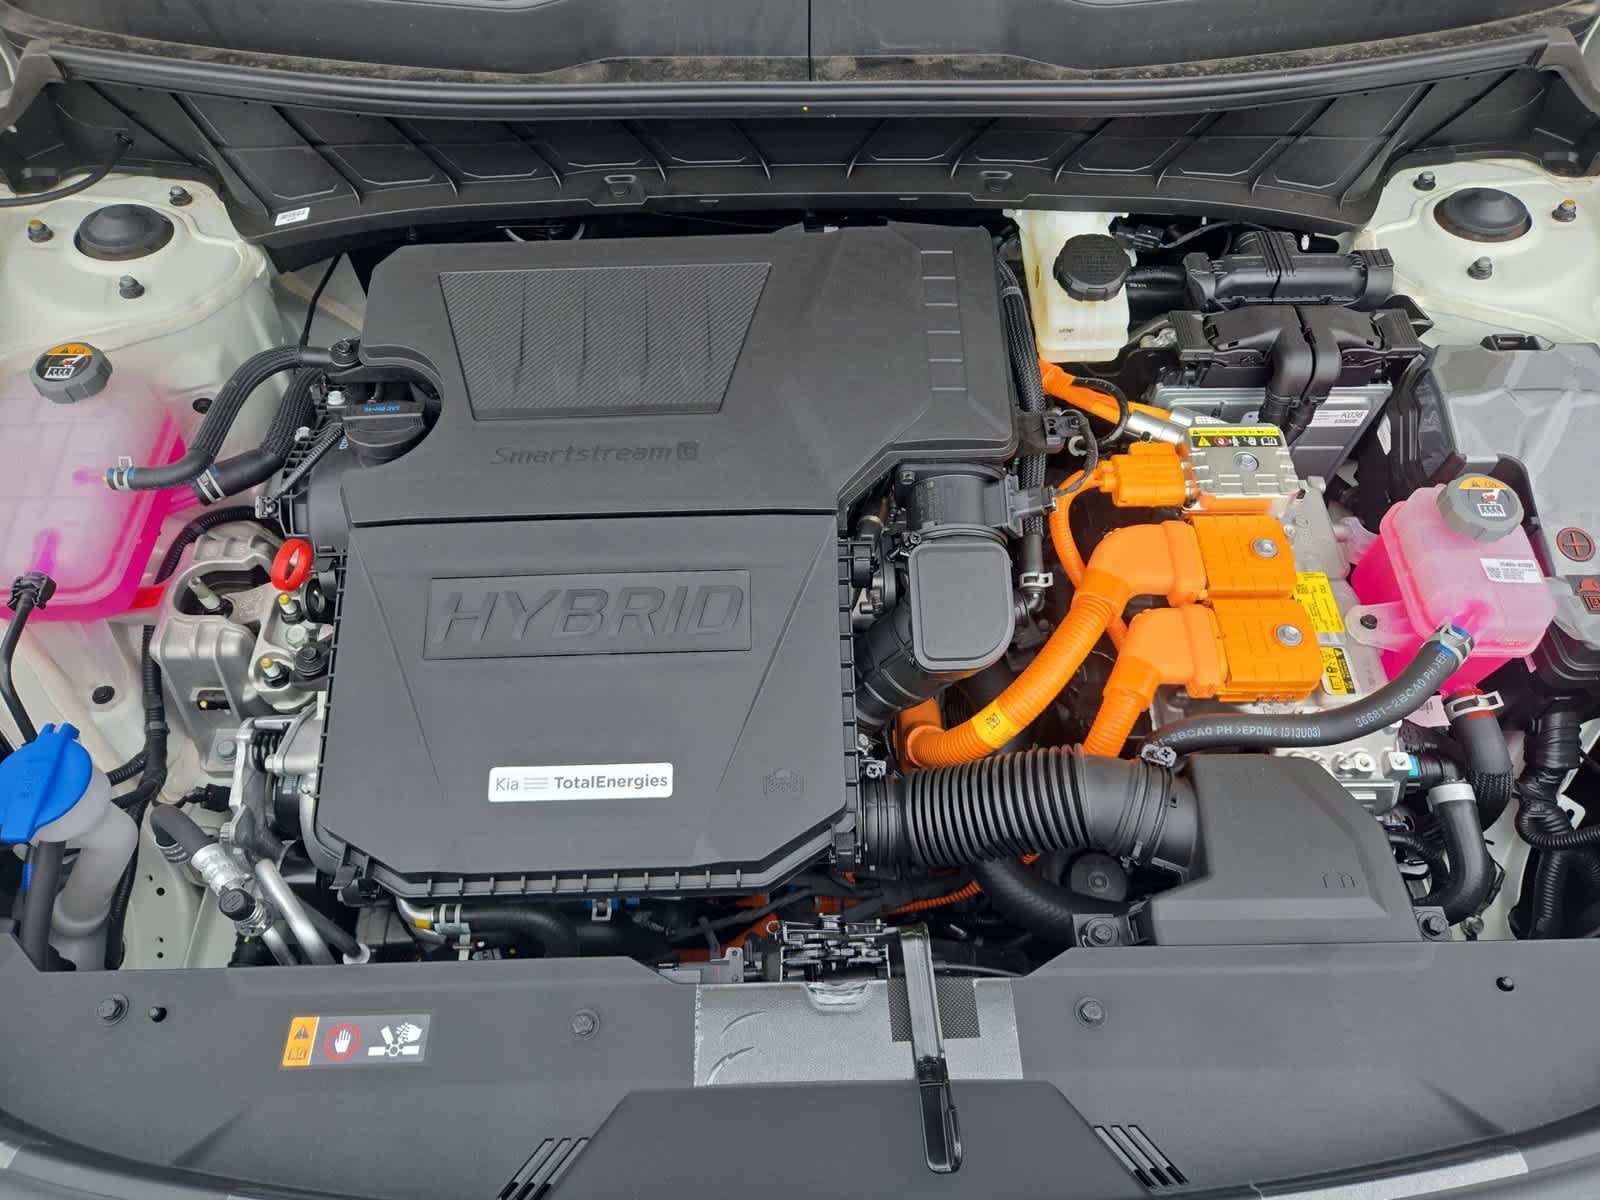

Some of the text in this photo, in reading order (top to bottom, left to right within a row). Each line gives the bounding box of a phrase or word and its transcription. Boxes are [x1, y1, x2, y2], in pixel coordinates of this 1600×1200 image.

[488, 443, 673, 465] Smartstream
[432, 584, 745, 642] HYBRID
[495, 774, 669, 791] Kia TotalEnergies
